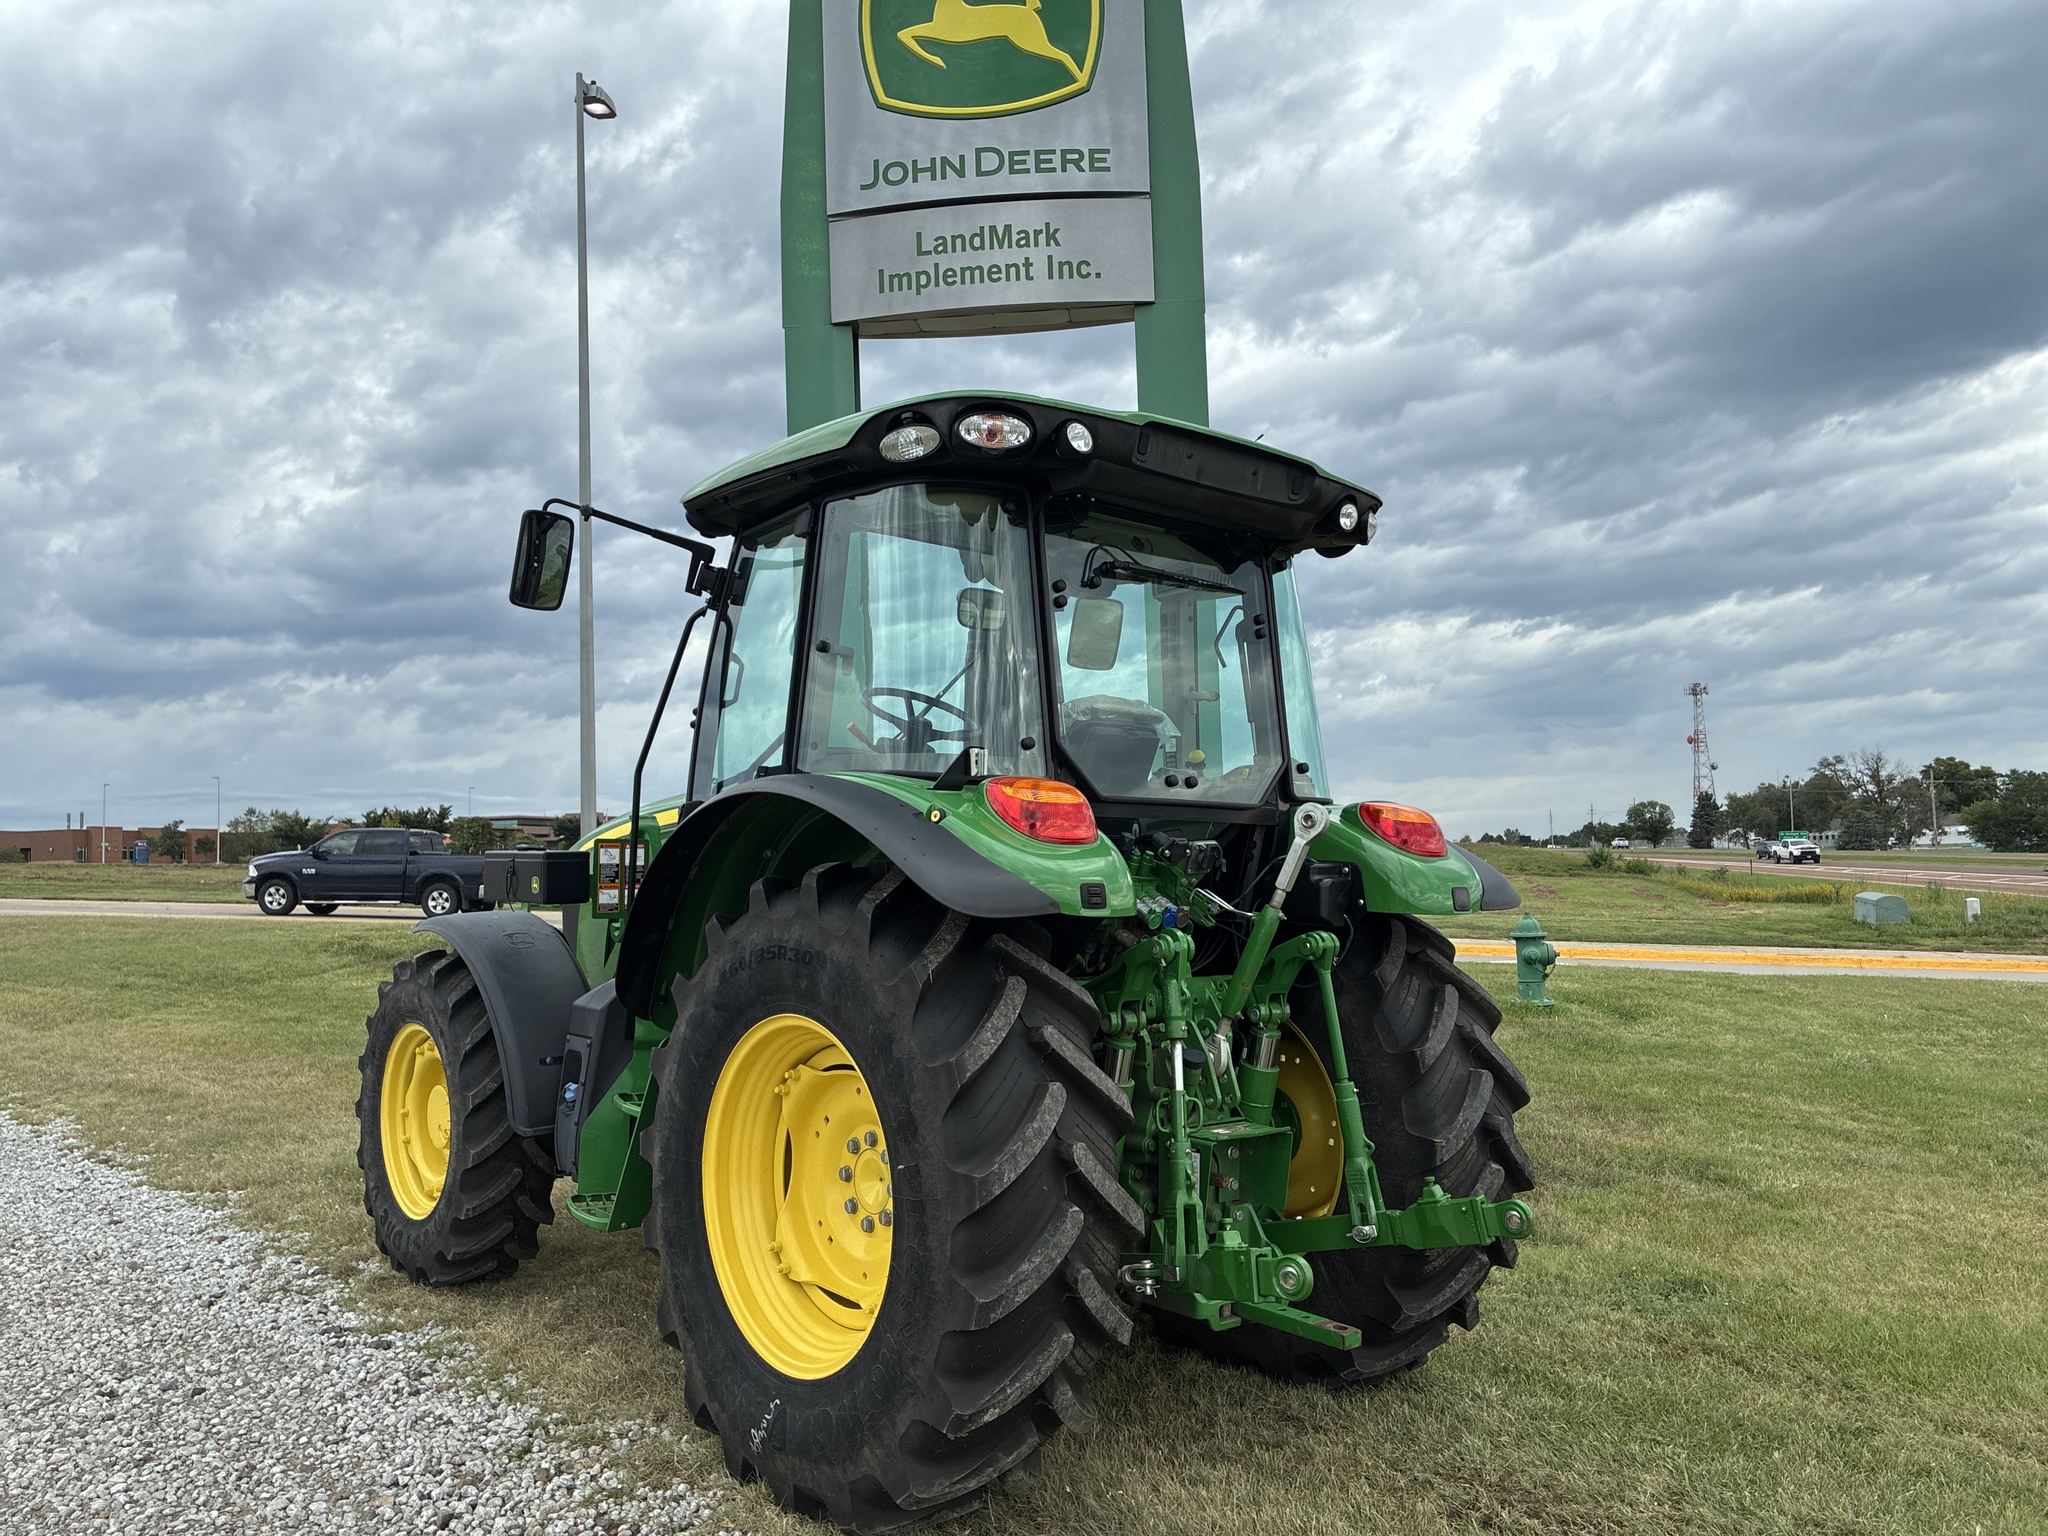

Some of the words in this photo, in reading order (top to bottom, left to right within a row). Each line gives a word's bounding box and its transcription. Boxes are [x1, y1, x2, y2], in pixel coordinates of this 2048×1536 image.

[859, 154, 966, 190] JOHN
[974, 146, 1111, 177] DEERE
[915, 222, 1062, 256] LandMark
[878, 257, 1034, 295] Implement
[1046, 254, 1102, 281] Inc.
